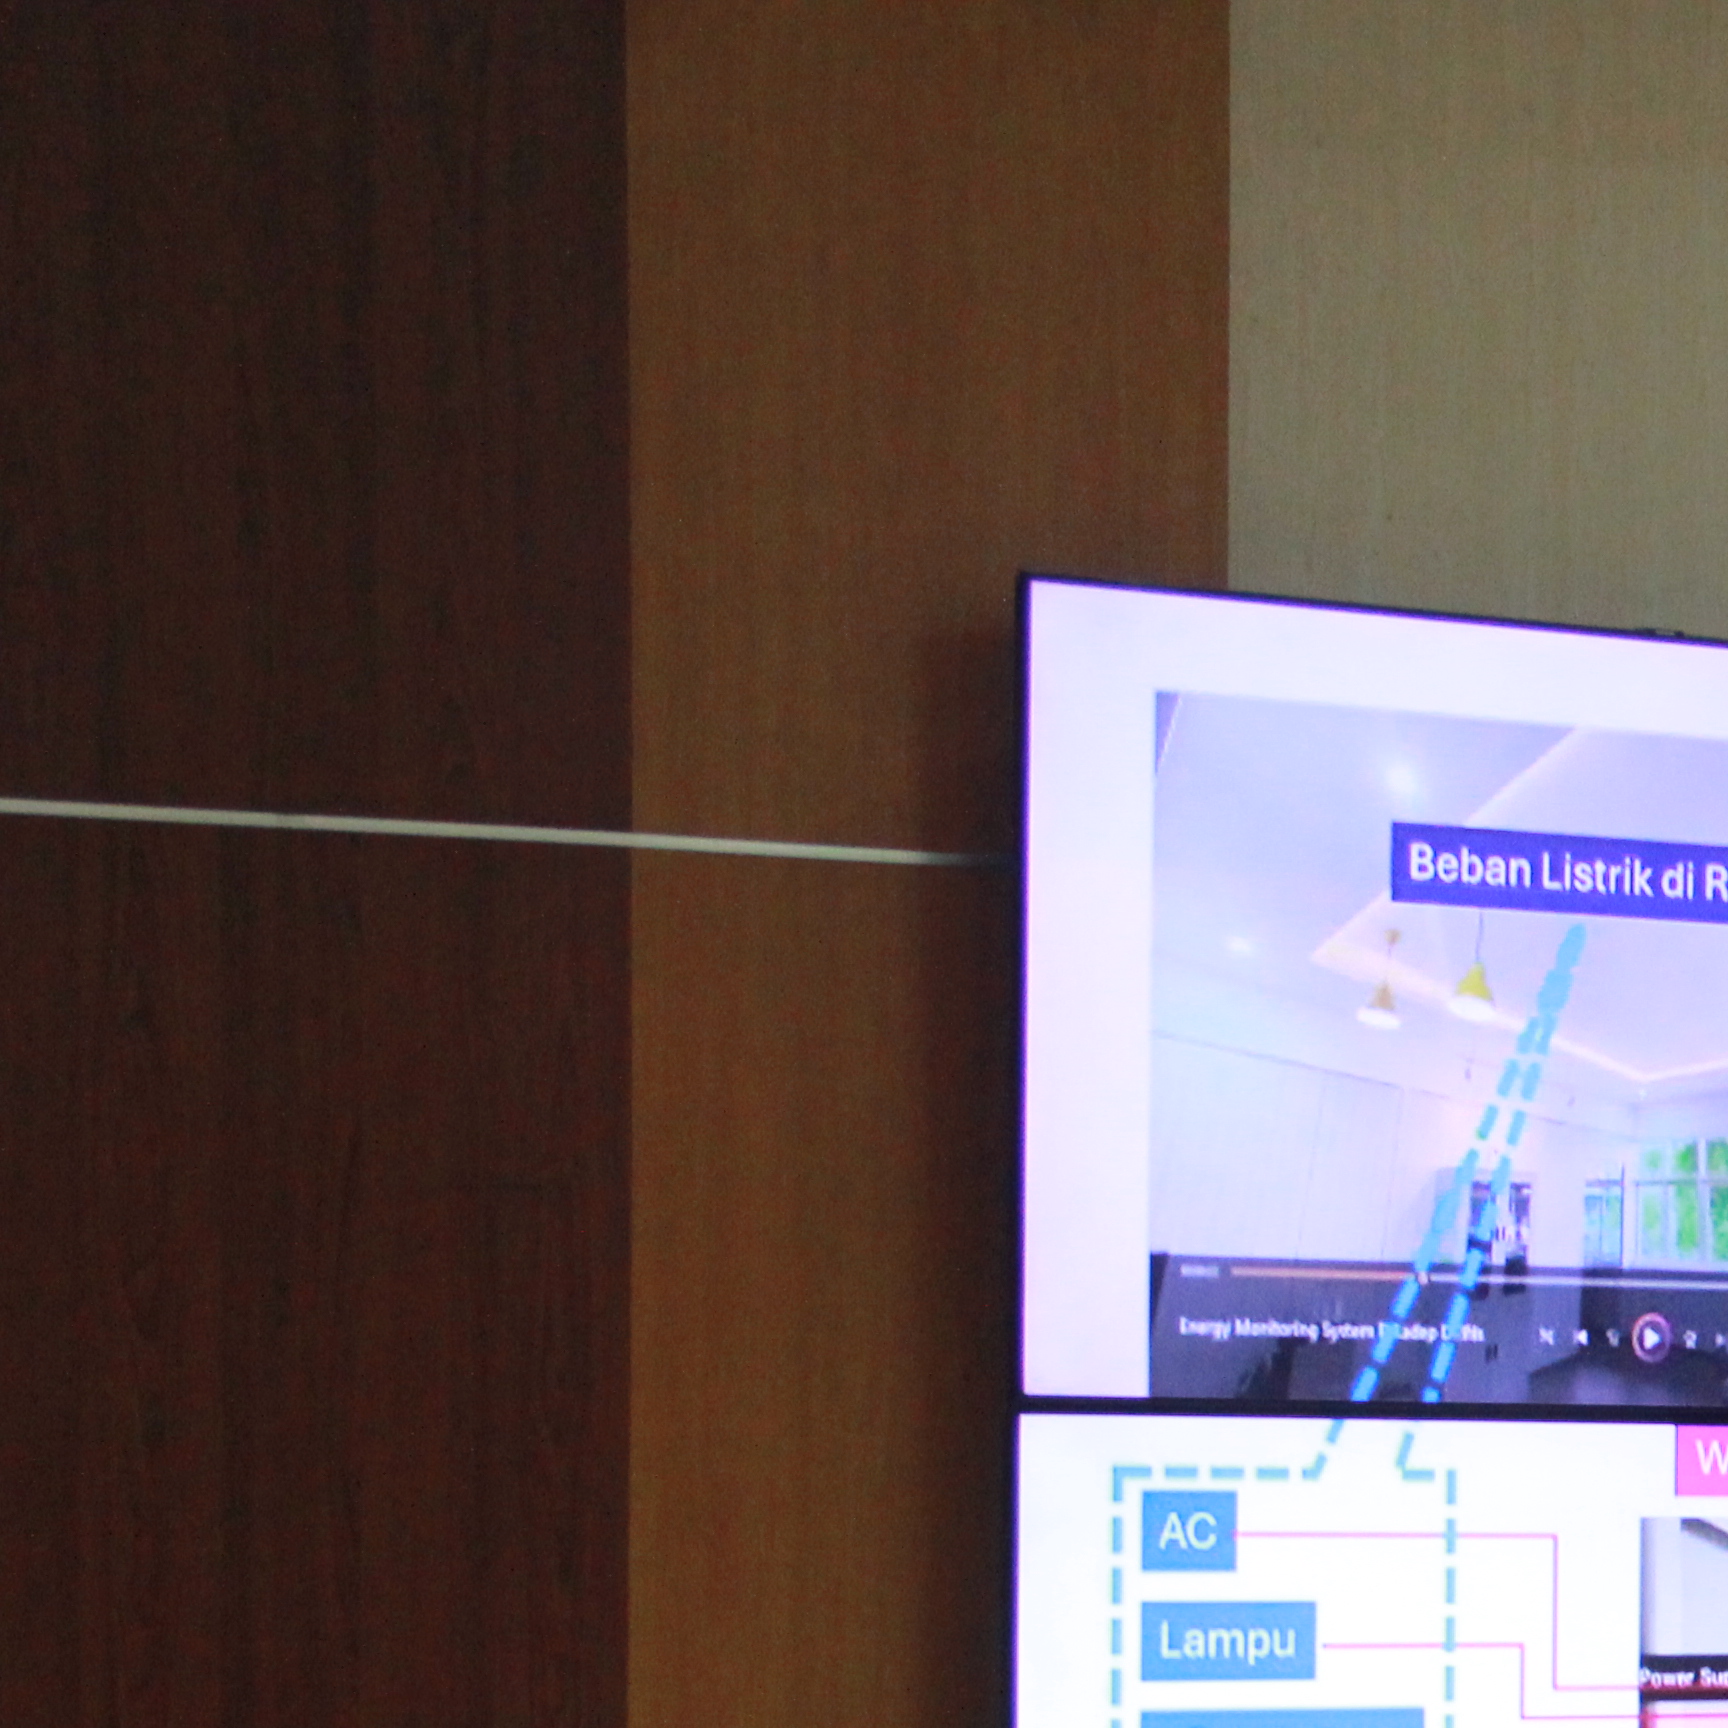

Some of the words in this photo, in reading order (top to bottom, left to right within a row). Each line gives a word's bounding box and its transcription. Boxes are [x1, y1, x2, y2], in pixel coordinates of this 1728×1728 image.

[1409, 842, 1530, 888] Beban
[1542, 852, 1653, 897] Listrik
[1661, 861, 1695, 900] di
[1159, 1512, 1217, 1550] AC
[1160, 1619, 1296, 1665] Lampu
